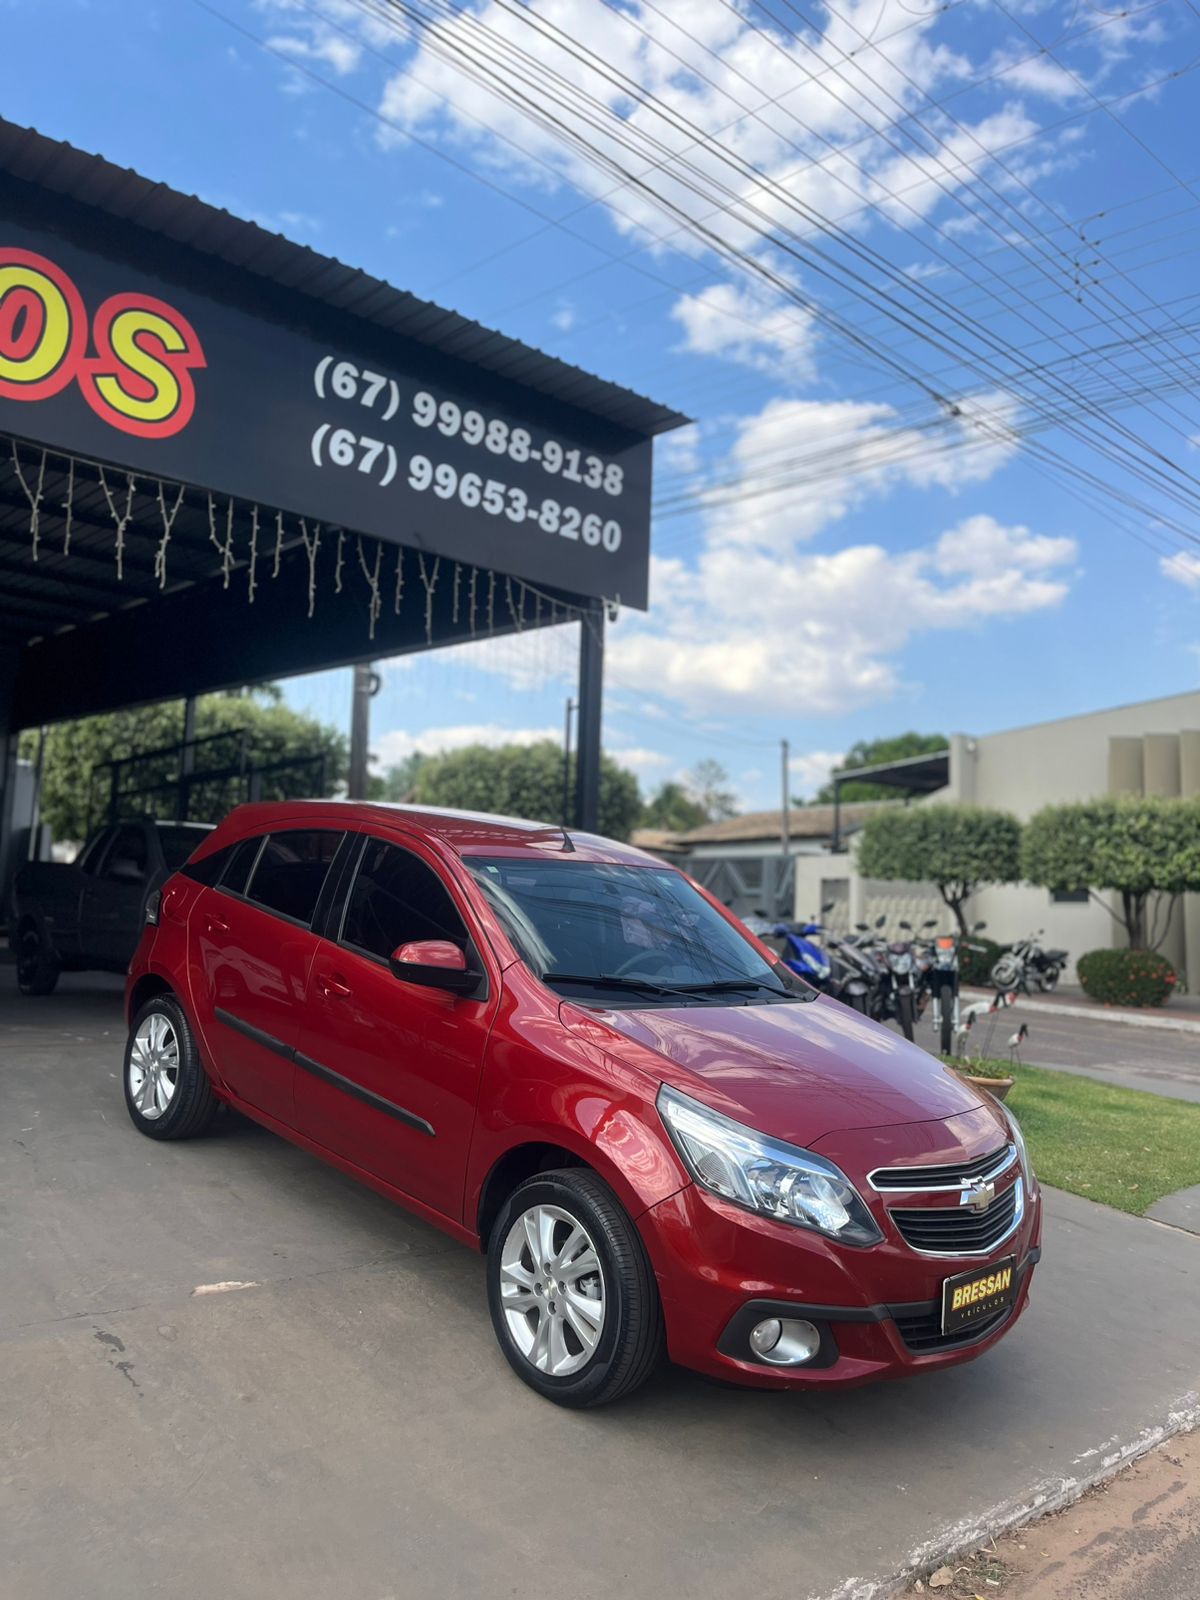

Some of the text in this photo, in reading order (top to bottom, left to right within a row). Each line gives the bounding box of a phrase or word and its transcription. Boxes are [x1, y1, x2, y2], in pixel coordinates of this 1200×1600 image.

[311, 423, 622, 553] (67) 99653-8260
[313, 355, 624, 496] (67) 99988-9138
[952, 1267, 1012, 1311] BRESSAN
